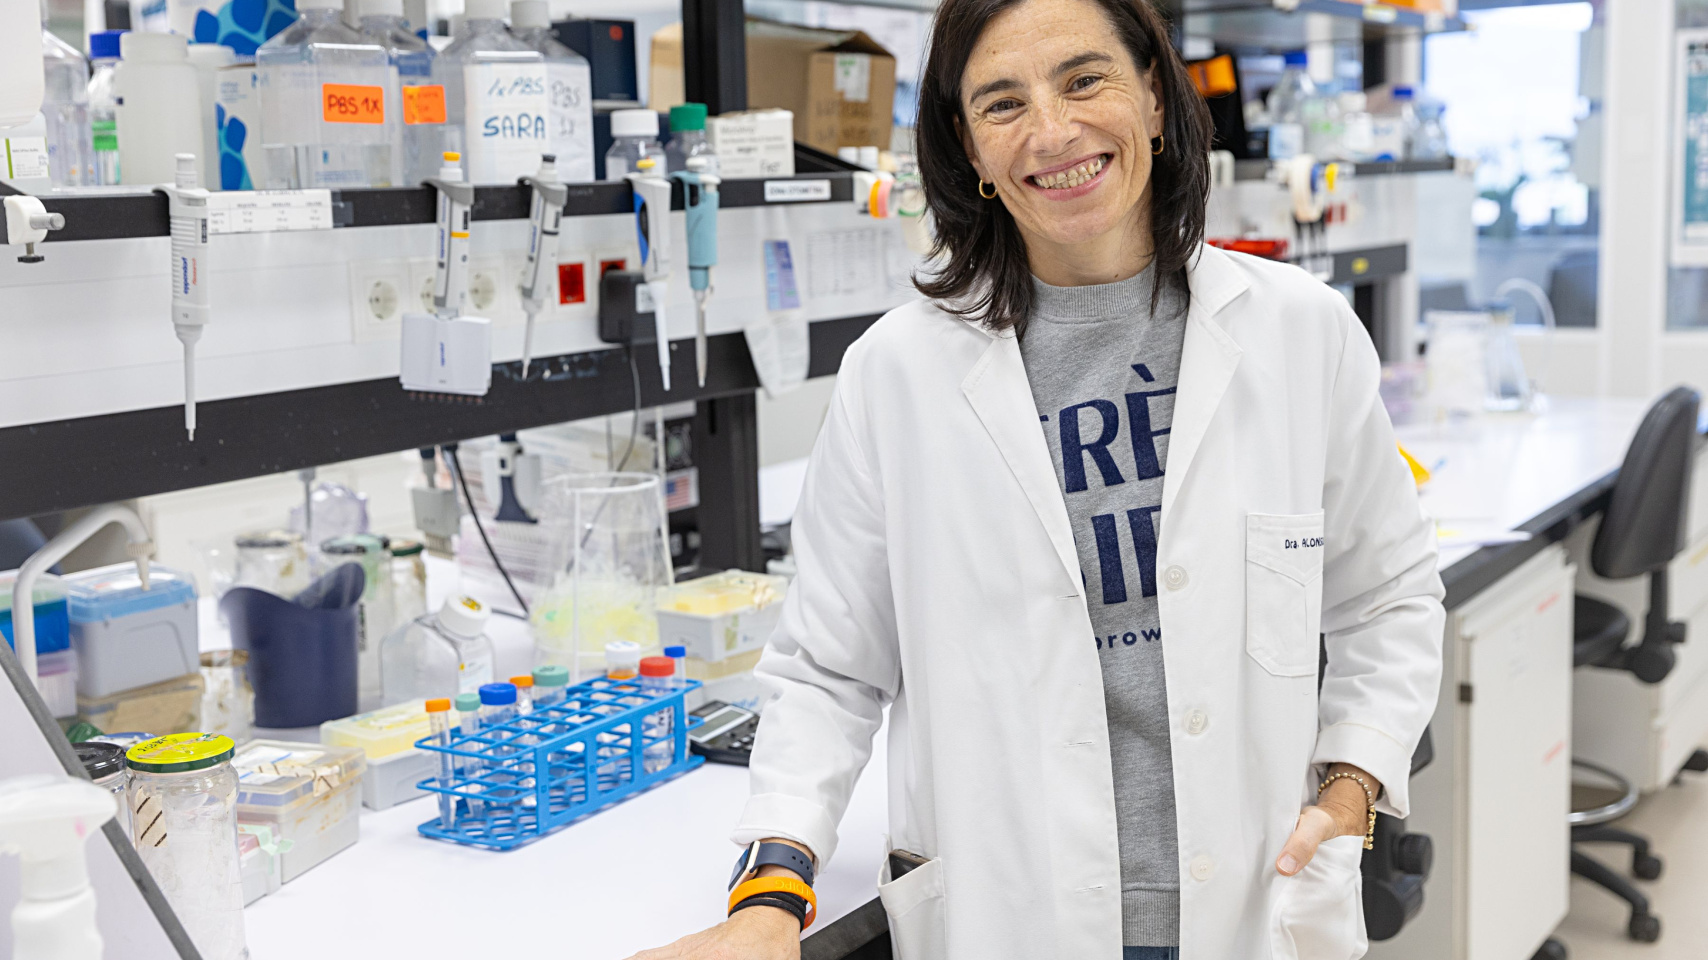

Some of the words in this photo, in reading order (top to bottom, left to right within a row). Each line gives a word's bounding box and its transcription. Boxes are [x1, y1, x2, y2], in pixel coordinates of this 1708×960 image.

[508, 76, 545, 95] PBS
[327, 94, 359, 115] PBS
[482, 113, 546, 138] SARA
[1284, 539, 1300, 549] Dra.
[774, 880, 804, 894] DIPG
